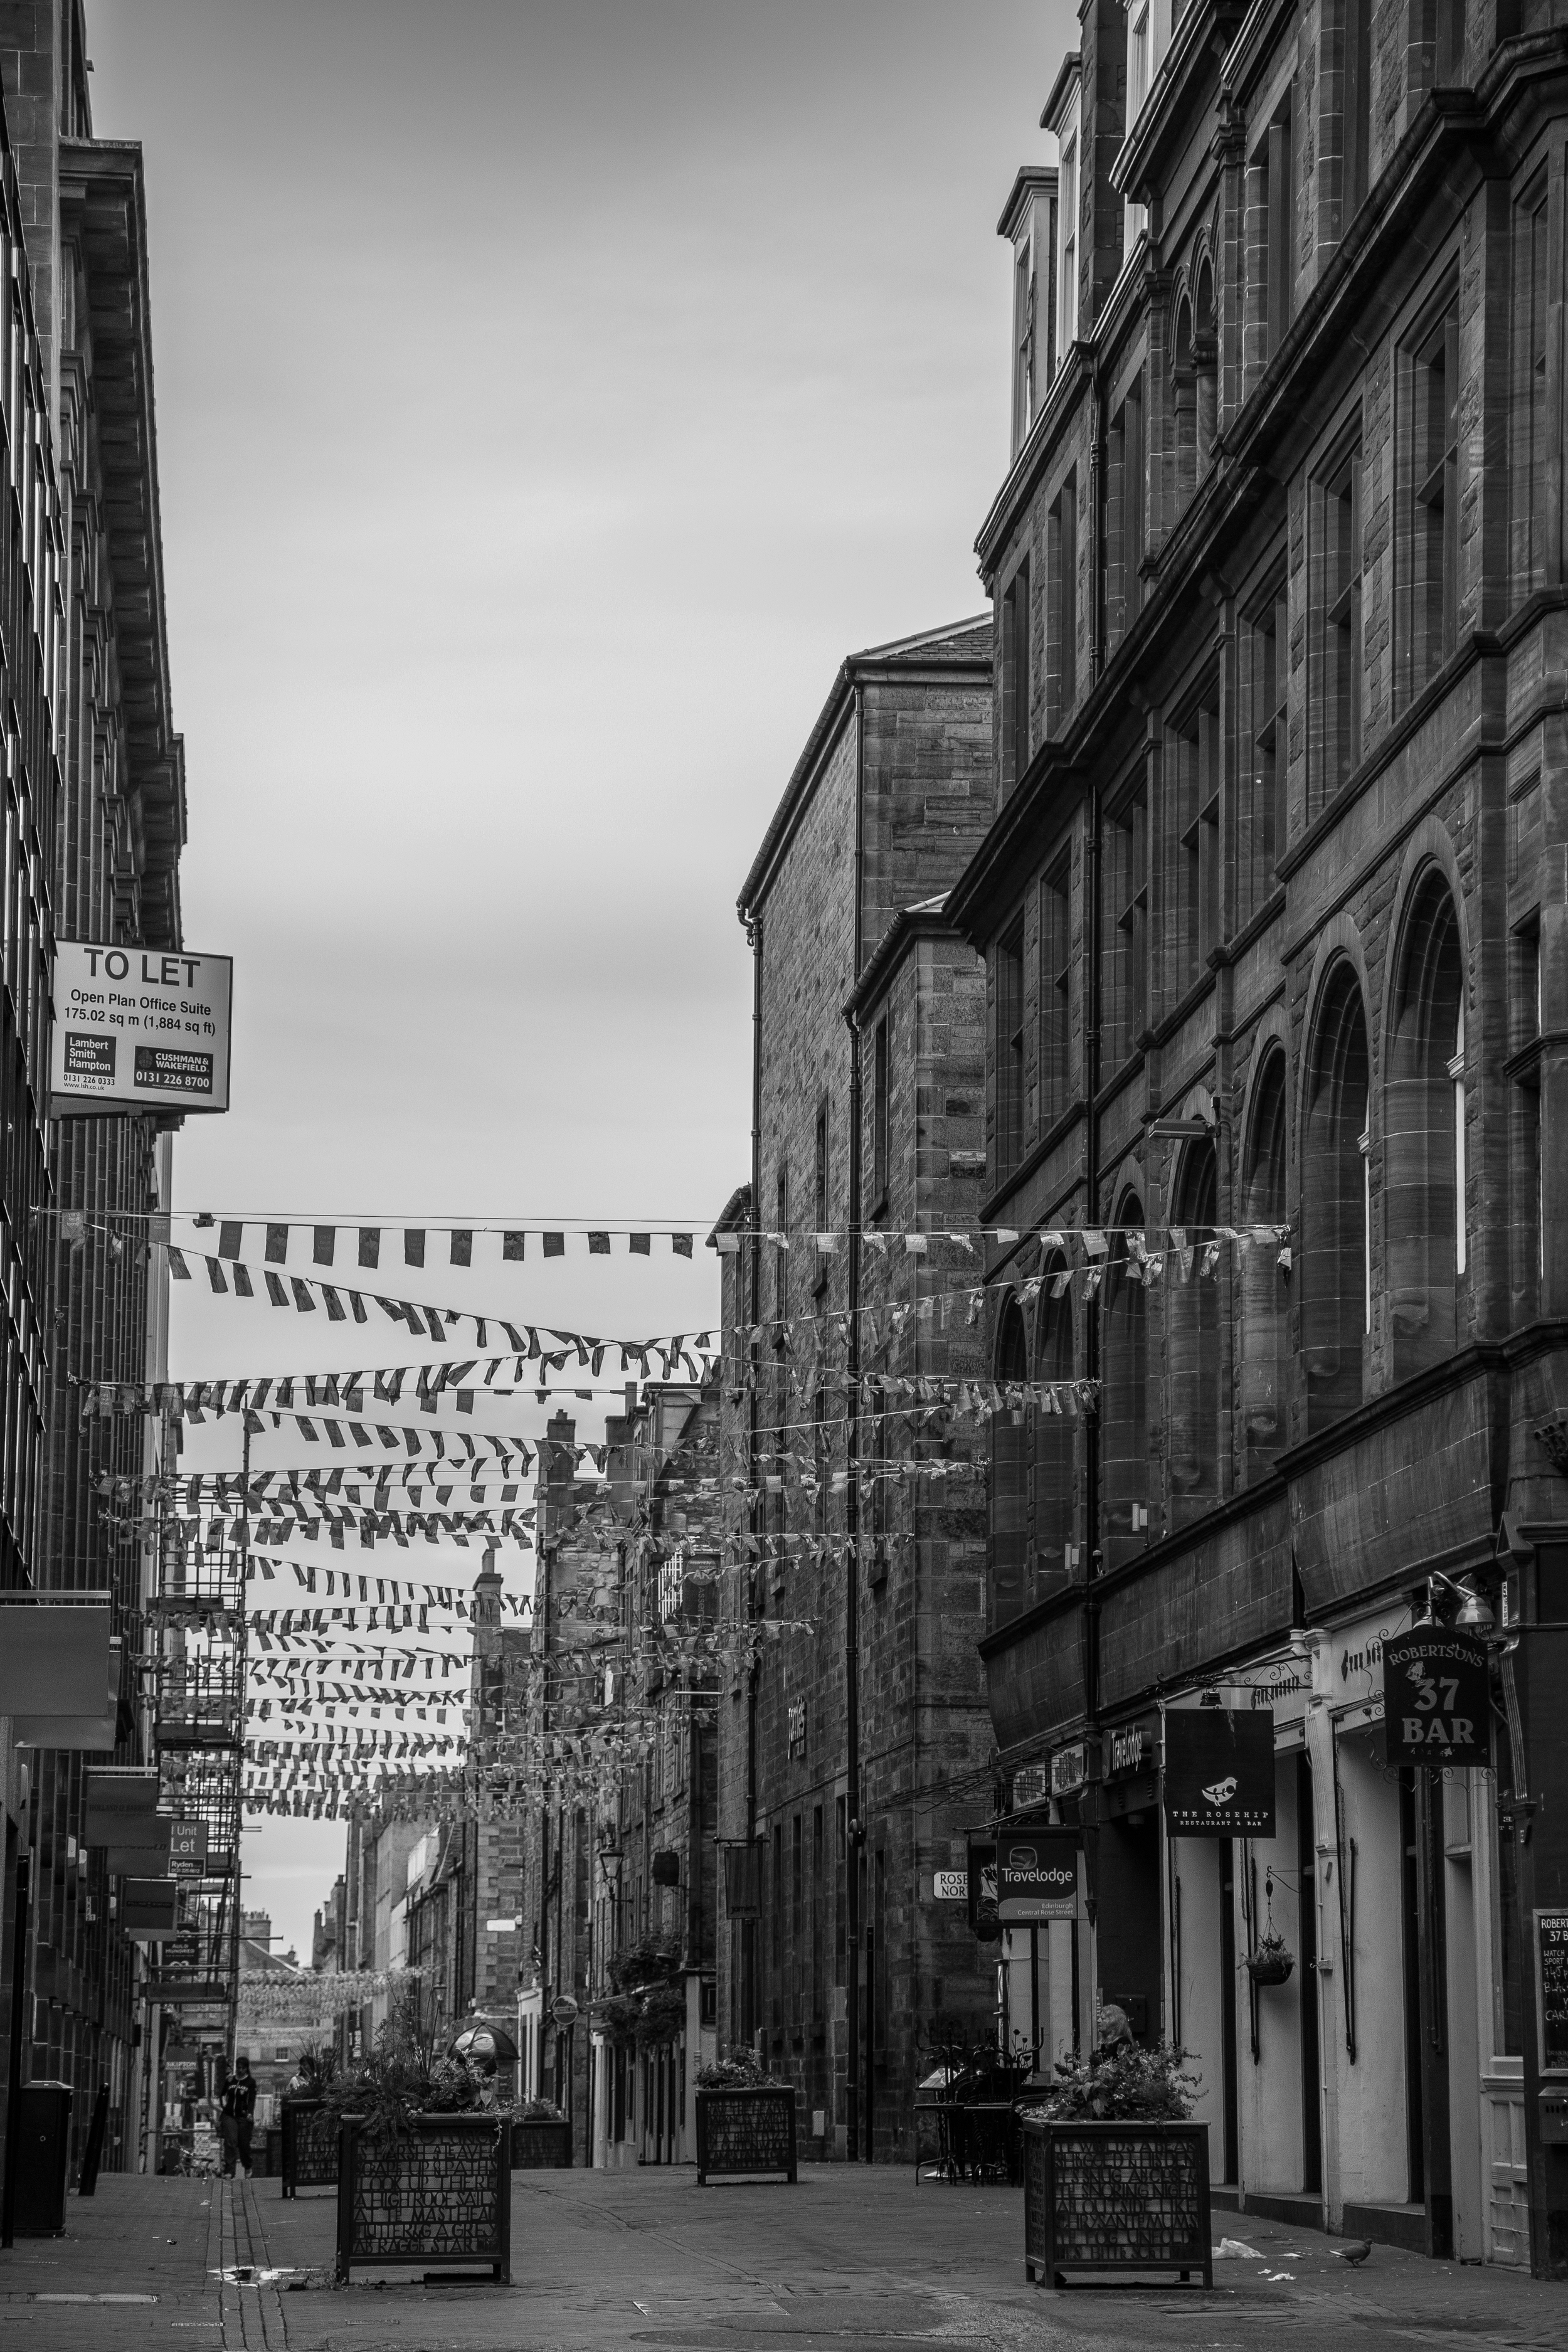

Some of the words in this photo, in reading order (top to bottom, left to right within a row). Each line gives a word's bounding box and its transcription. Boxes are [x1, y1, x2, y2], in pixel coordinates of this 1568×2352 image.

[84, 948, 129, 980] TO
[142, 954, 200, 988] LET
[71, 989, 104, 1004] Open
[109, 993, 135, 1007] Plan
[140, 997, 176, 1012] Office
[180, 1001, 211, 1015] Suite
[65, 1007, 105, 1021] 175.02
[109, 1014, 124, 1027] sq
[128, 1016, 139, 1025] m
[144, 1015, 181, 1030] (1,884
[184, 1022, 199, 1035] sq
[203, 1022, 216, 1036] ft)
[70, 1037, 109, 1050] Lambert
[70, 1048, 96, 1059] Smith
[156, 1052, 201, 1064] CUSHMAN
[69, 1057, 110, 1071] Hampton
[63, 1074, 80, 1083] 0131
[136, 1071, 159, 1082] 0131
[164, 1074, 182, 1084] 226
[184, 1076, 209, 1088] 8700
[63, 1082, 105, 1091] www.lsh.co.uk
[1414, 1677, 1459, 1711] 37
[1402, 1718, 1475, 1744] BAR
[177, 1826, 197, 1836] Unit
[171, 1837, 195, 1852] Let
[171, 1860, 194, 1868] Ryden
[940, 1874, 968, 1885] ROSE
[1002, 1868, 1073, 1885] Travelodge
[941, 1886, 968, 1897] NOR
[1549, 1931, 1560, 1941] 37
